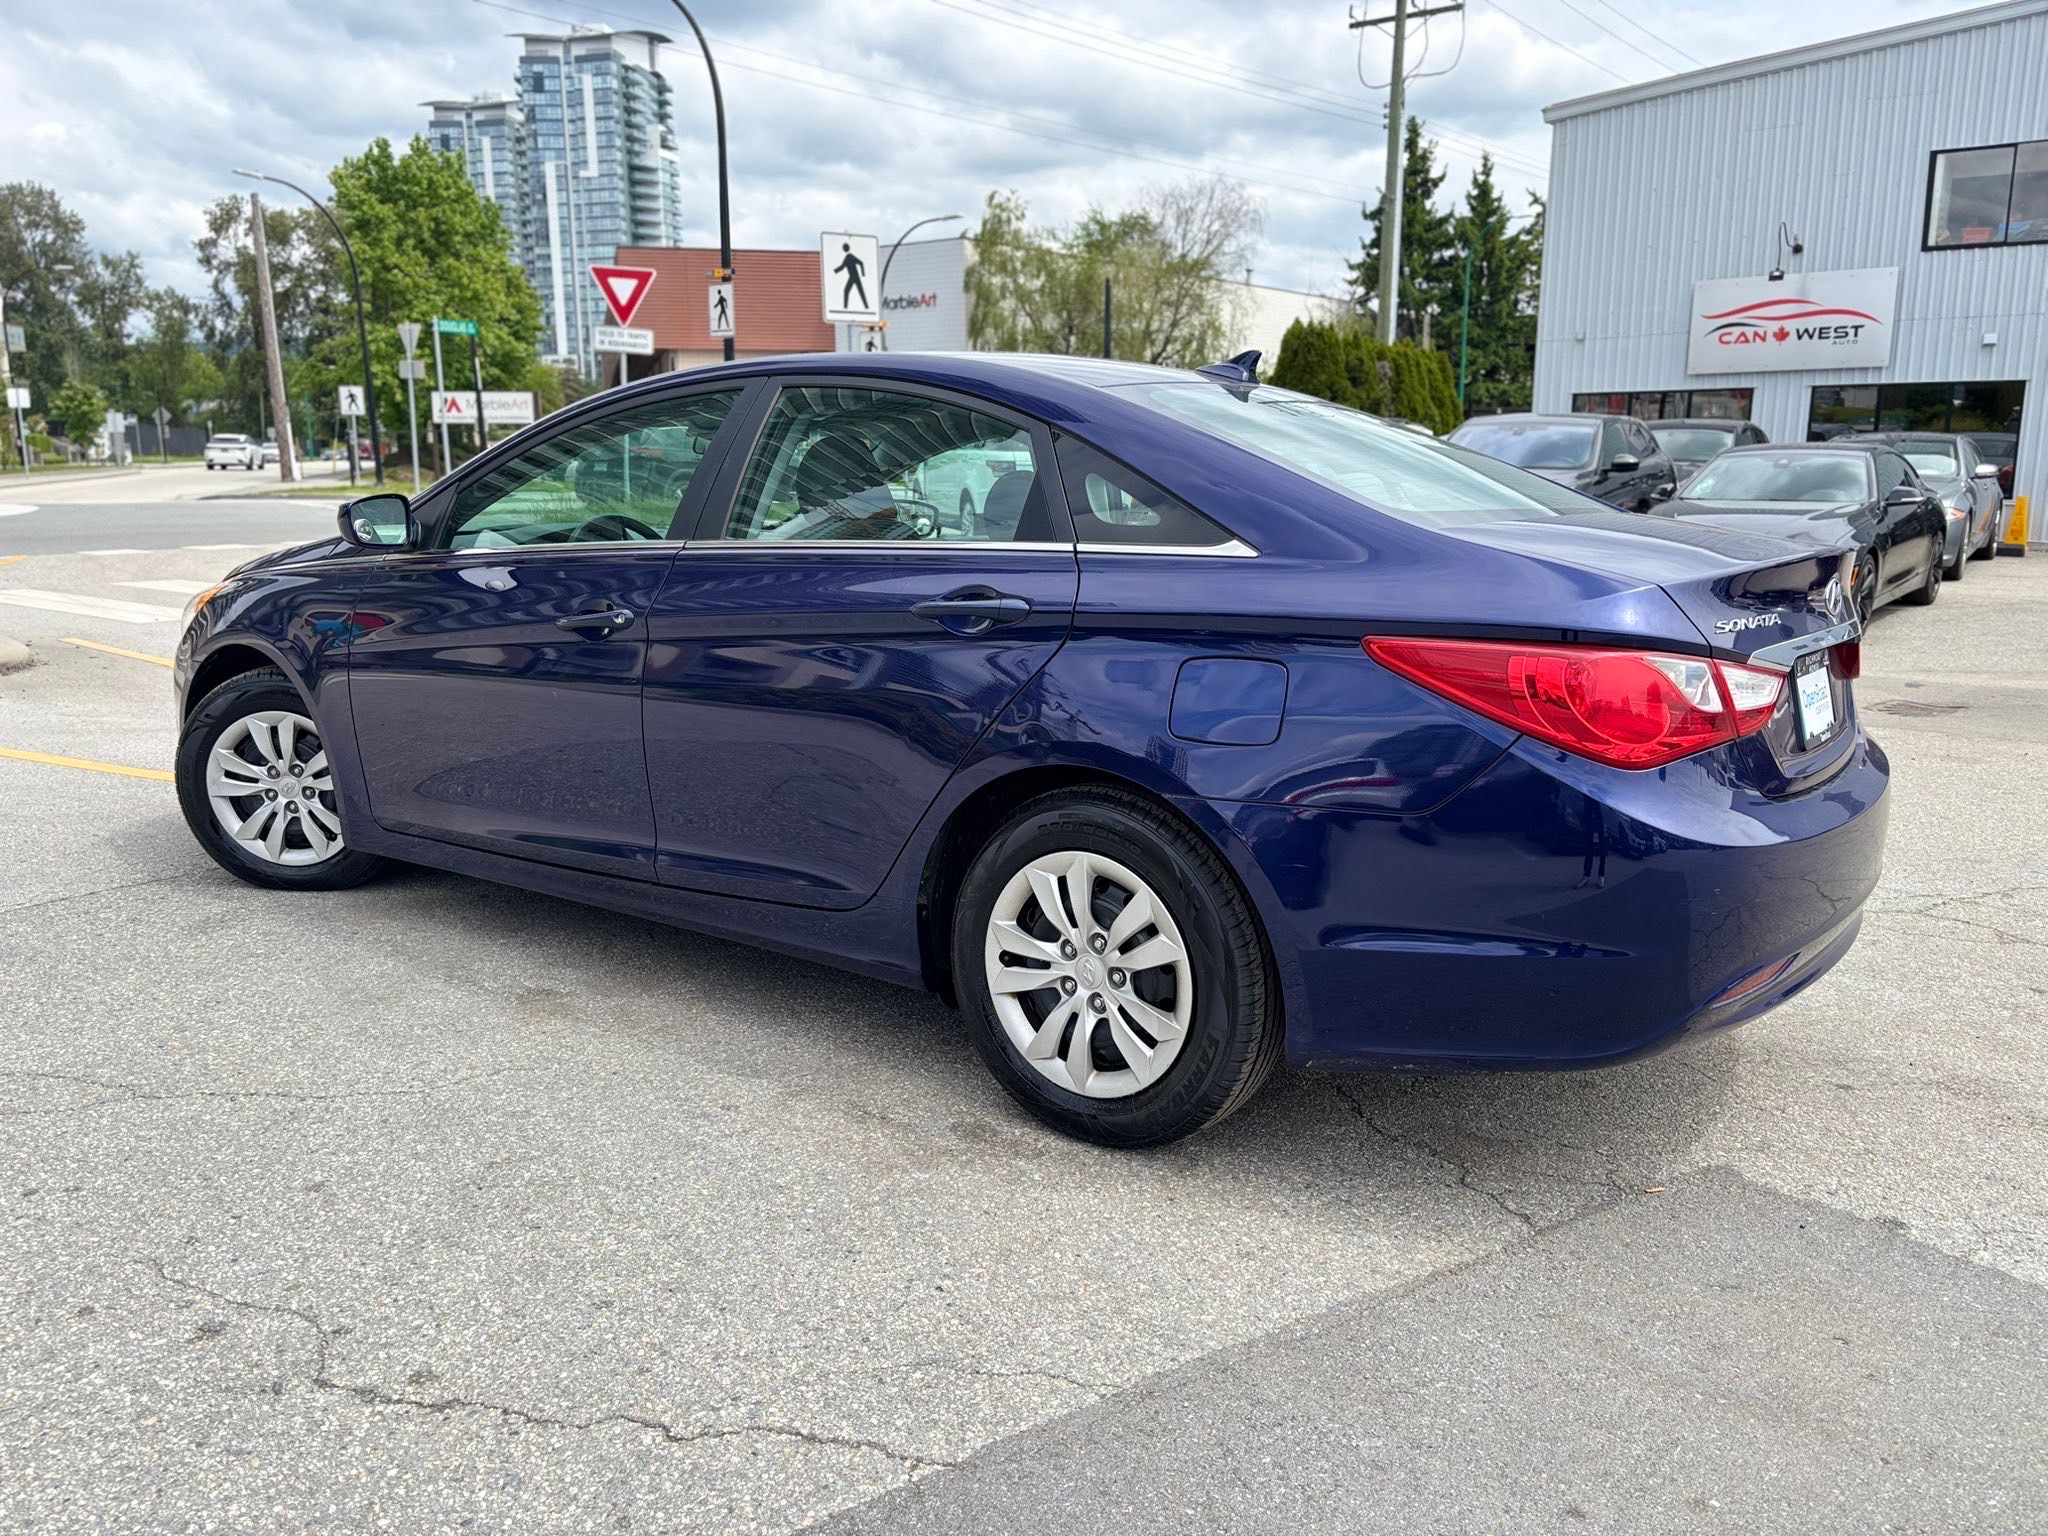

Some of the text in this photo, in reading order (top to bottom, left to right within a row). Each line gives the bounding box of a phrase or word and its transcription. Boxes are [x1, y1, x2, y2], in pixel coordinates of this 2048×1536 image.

[1718, 325, 1865, 345] CAN WEST
[1715, 613, 1782, 633] SONATA
